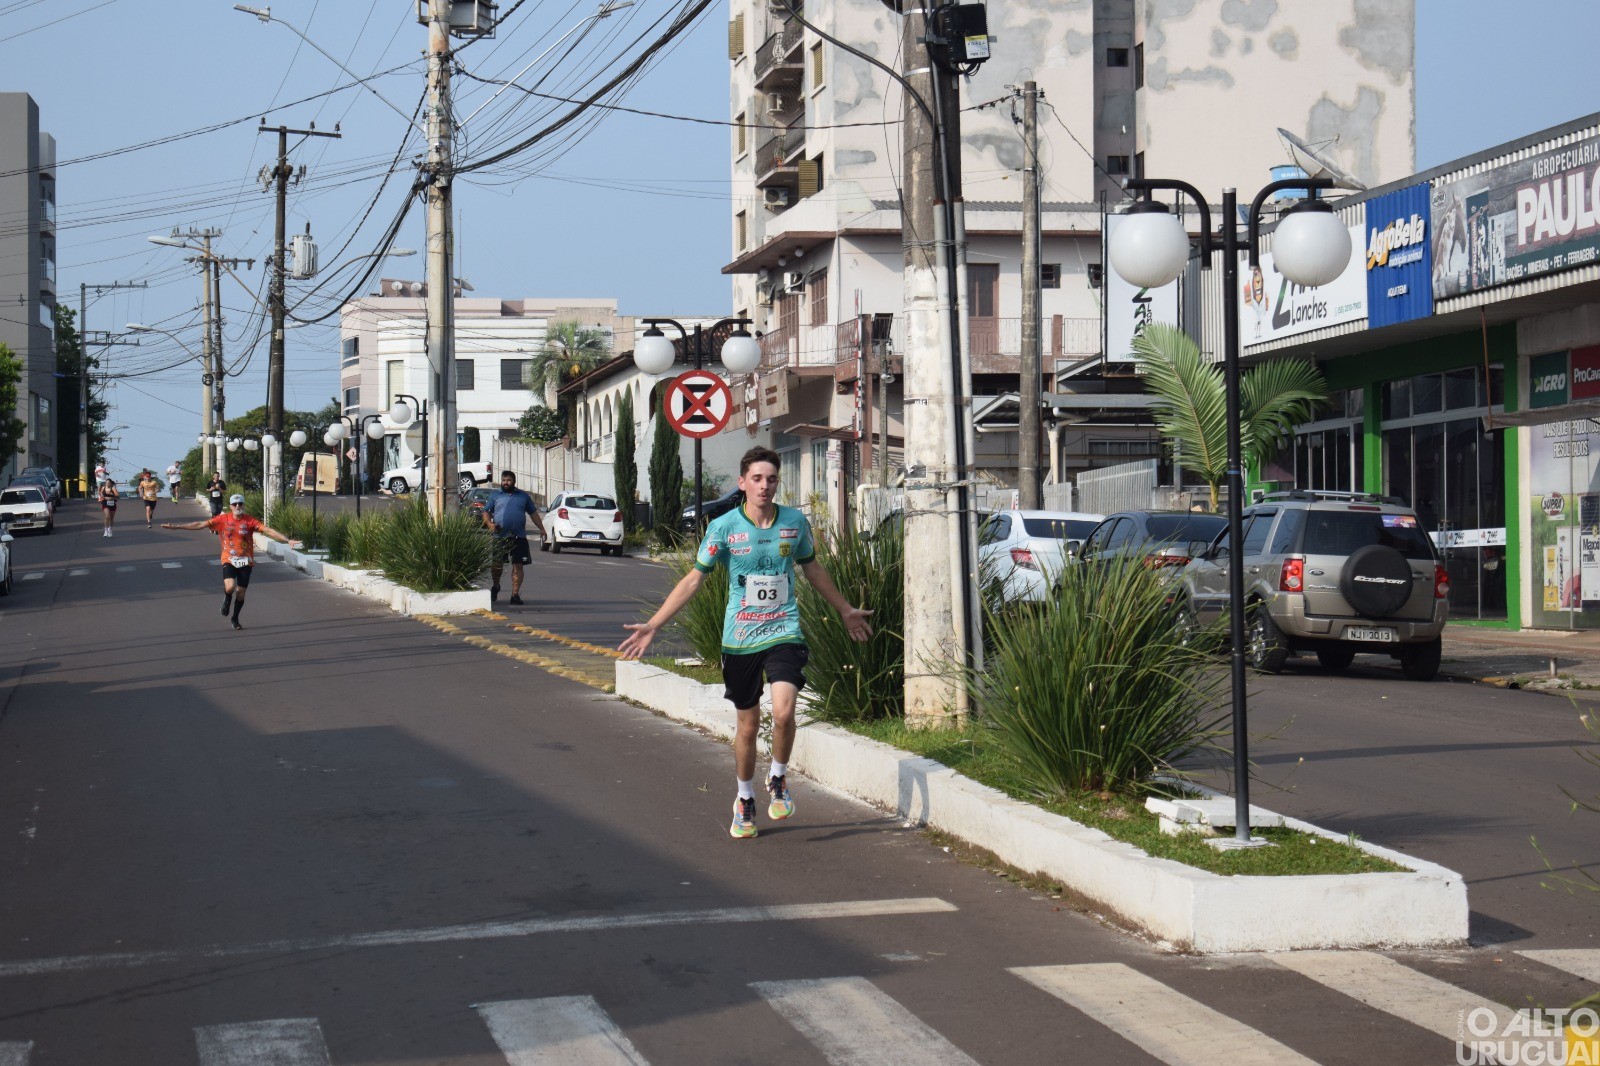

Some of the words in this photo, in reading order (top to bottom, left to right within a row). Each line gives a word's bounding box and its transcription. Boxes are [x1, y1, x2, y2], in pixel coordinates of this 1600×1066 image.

[1532, 142, 1599, 180] AGROPECUÁRIA
[1553, 254, 1563, 269] PET
[1567, 246, 1596, 265] FERRAGENS
[1291, 295, 1327, 326] Lanches
[1534, 373, 1566, 393] AGRO
[1543, 499, 1562, 511] SUPRA
[757, 589, 777, 600] 03
[1368, 631, 1390, 640] 3013
